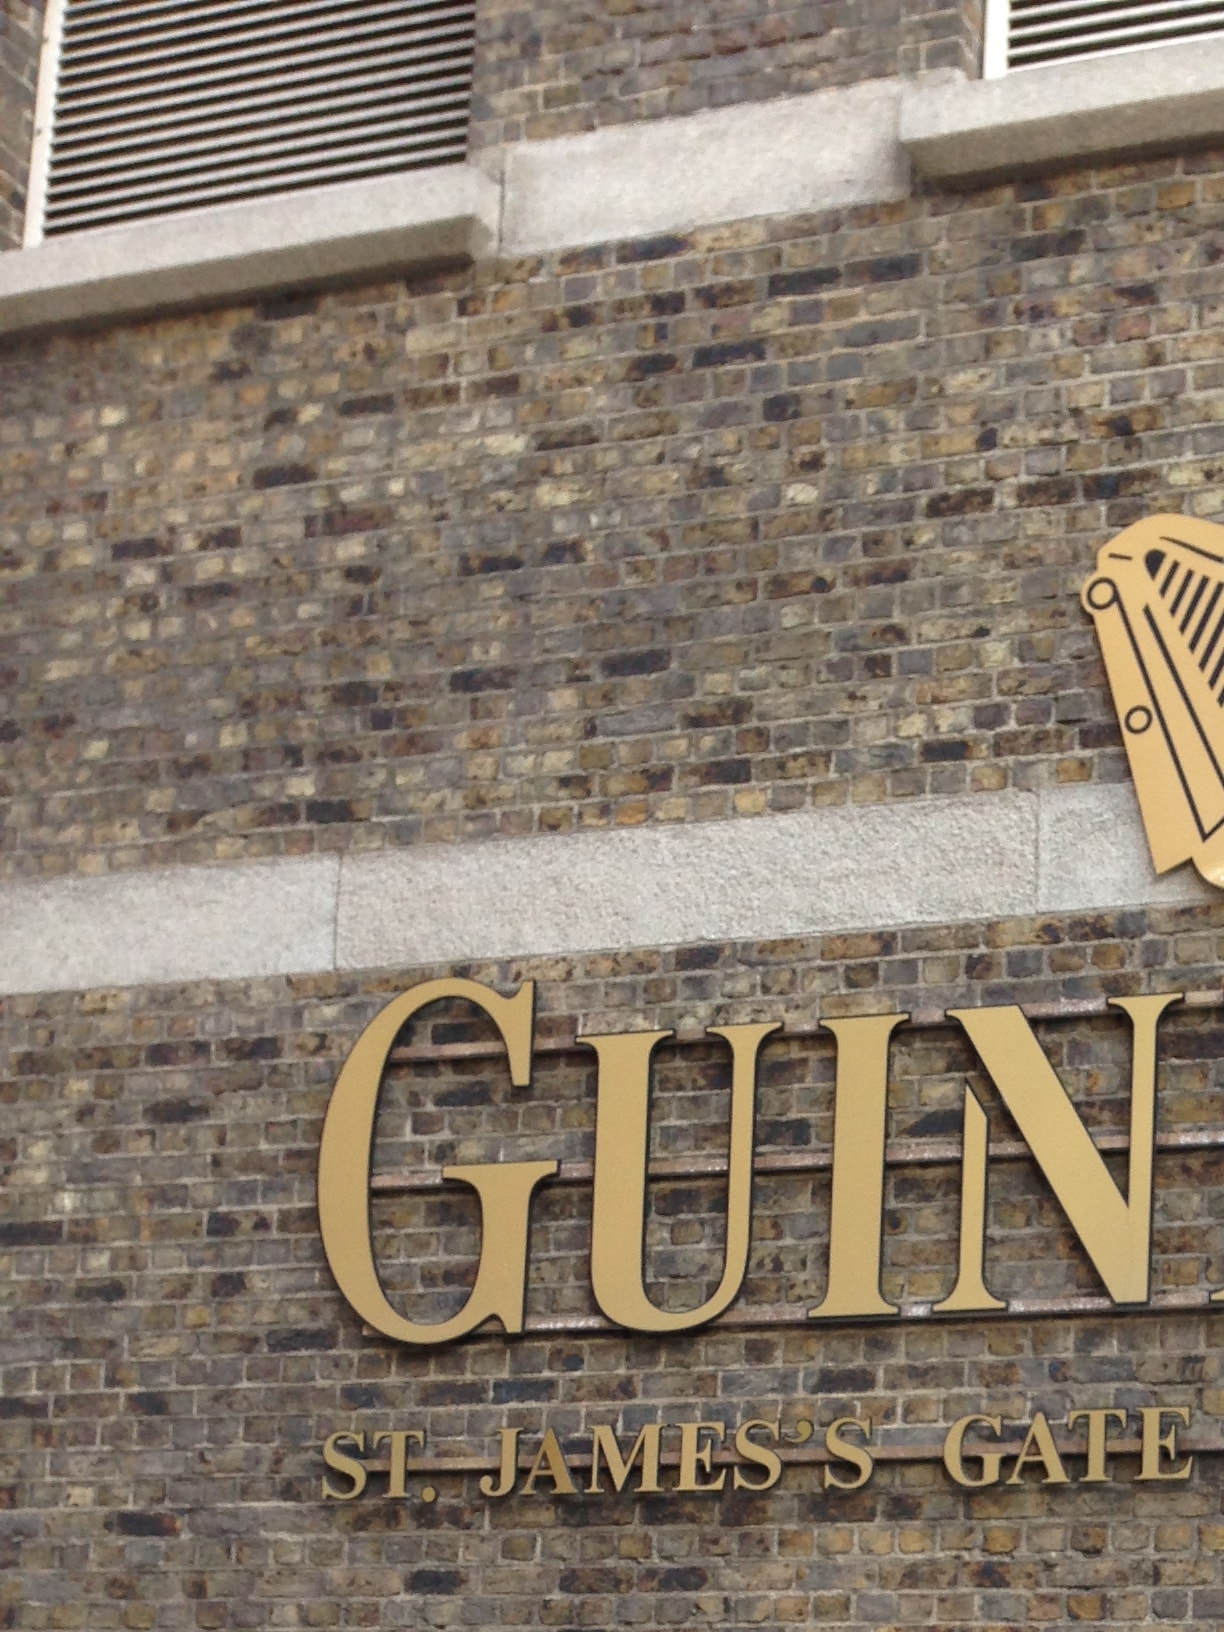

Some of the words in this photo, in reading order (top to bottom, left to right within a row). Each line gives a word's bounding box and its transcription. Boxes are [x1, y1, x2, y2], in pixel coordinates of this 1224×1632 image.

[321, 1429, 437, 1503] ST.
[479, 1416, 875, 1499] JAMES'S
[942, 1405, 1194, 1488] GATE
